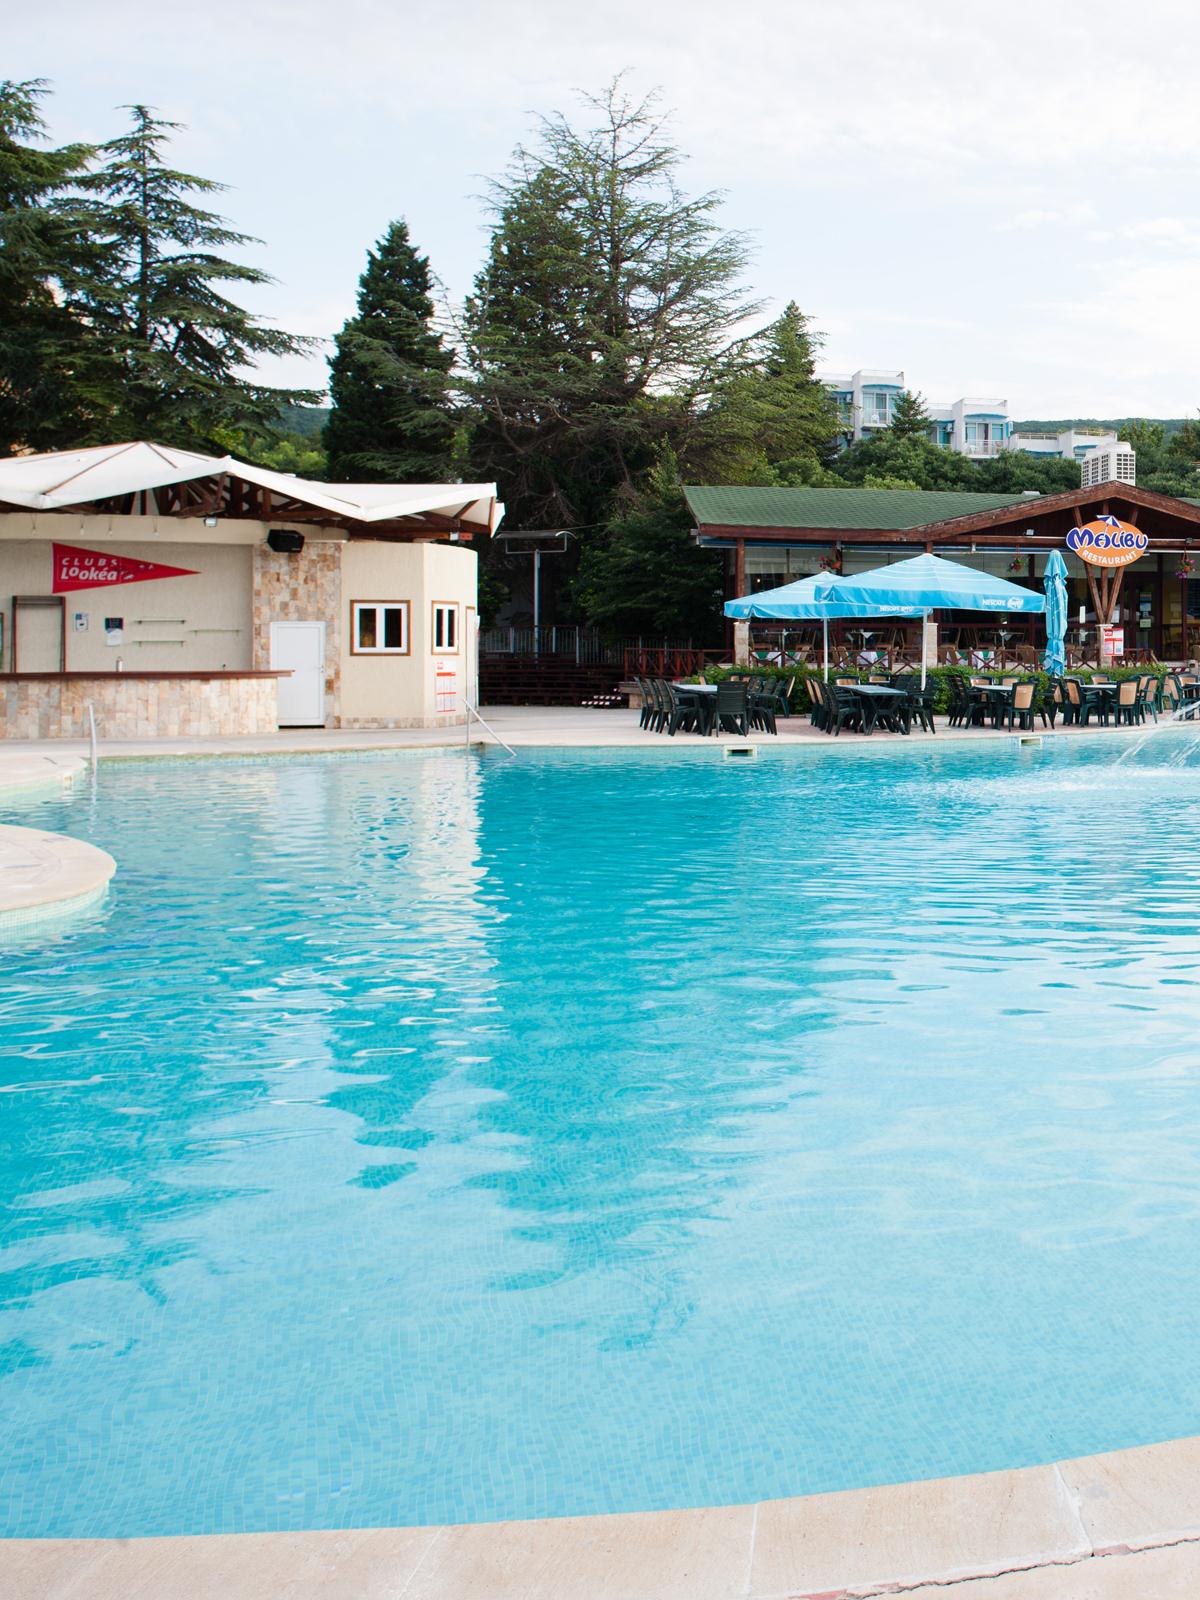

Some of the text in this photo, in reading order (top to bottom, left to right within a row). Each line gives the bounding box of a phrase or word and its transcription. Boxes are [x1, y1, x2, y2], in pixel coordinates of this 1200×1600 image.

[62, 557, 118, 566] CLUBS
[1082, 550, 1137, 565] RESTAURANT
[61, 566, 118, 581] Lookéa
